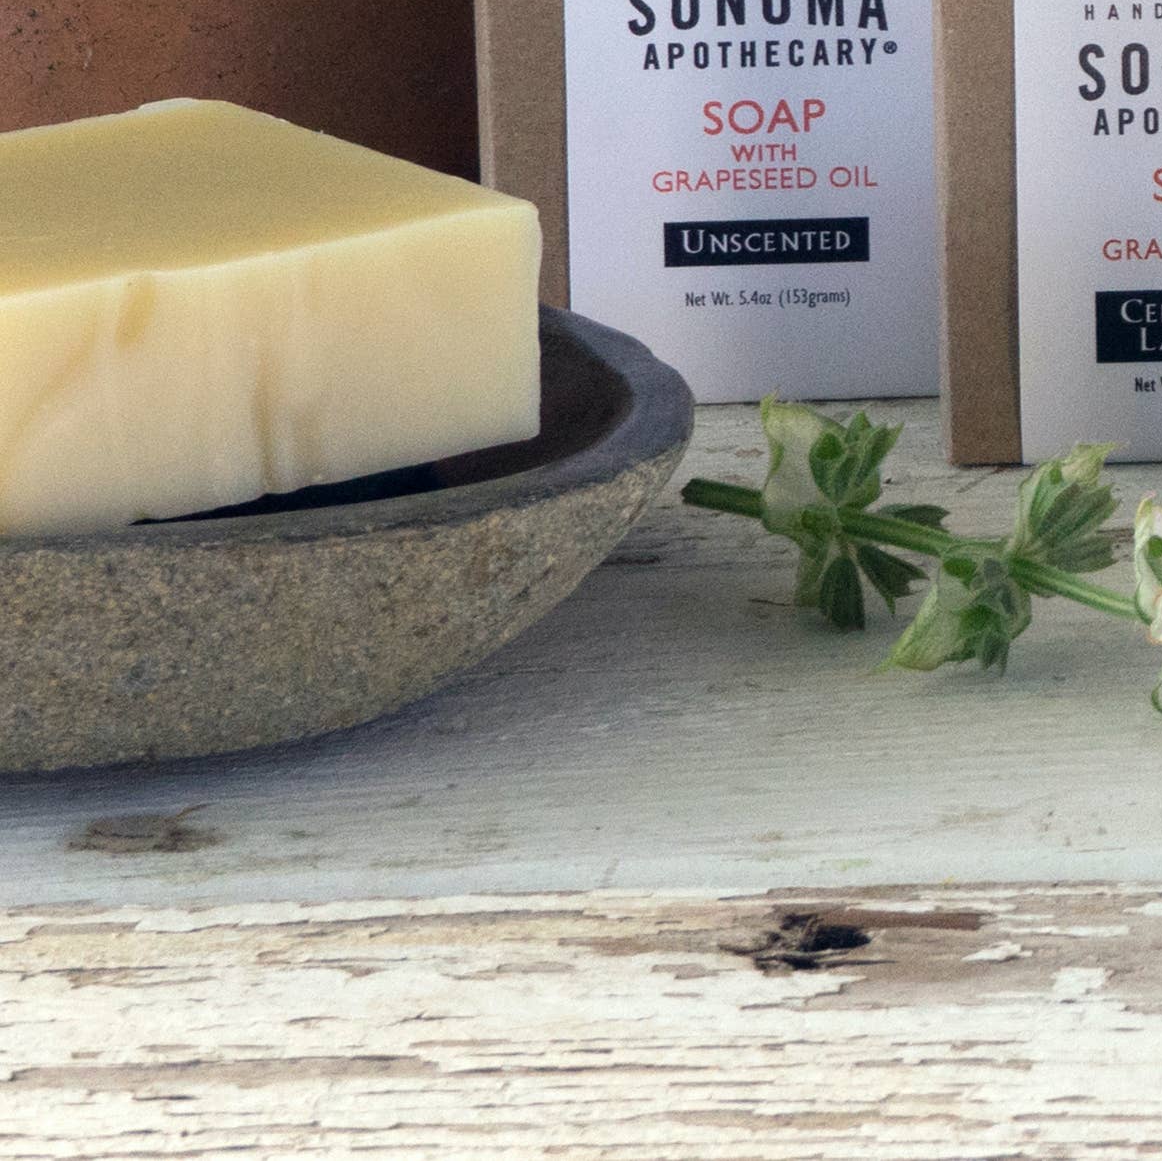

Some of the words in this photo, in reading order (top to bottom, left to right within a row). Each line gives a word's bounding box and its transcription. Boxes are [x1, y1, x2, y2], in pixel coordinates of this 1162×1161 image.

[703, 99, 826, 135] SOAP
[731, 143, 797, 162] WITH
[652, 167, 817, 193] GRAPESEED
[829, 166, 878, 188] OIL
[685, 292, 705, 306] Net
[711, 291, 733, 306] Wt.
[739, 290, 771, 305] 5.4oz
[779, 289, 850, 308] (153grams)
[1135, 377, 1155, 392] Net
